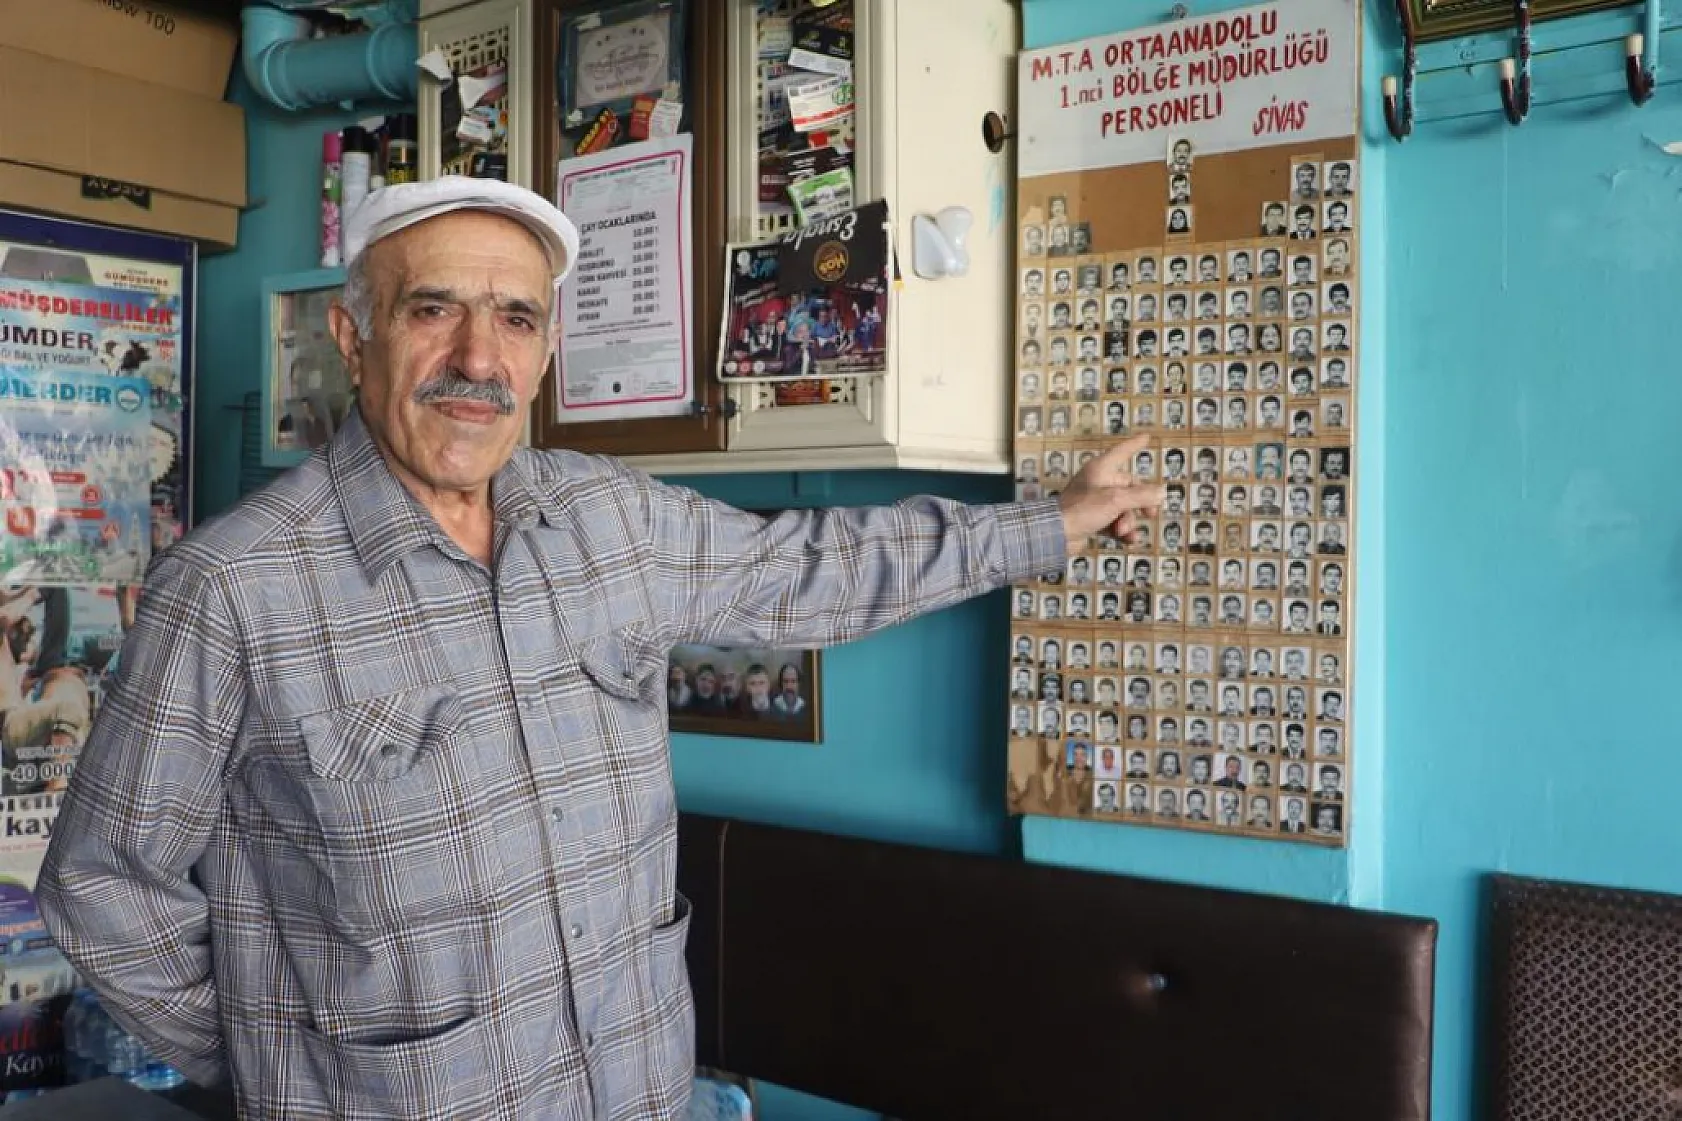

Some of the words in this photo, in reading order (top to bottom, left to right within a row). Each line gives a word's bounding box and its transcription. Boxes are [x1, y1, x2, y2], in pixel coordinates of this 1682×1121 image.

[1031, 50, 1093, 81] M.T.A
[1104, 10, 1278, 67] ORTAANADOLU
[1188, 29, 1329, 88] MÜDÜRLÜĞÜ
[1253, 95, 1309, 136] SİVAS
